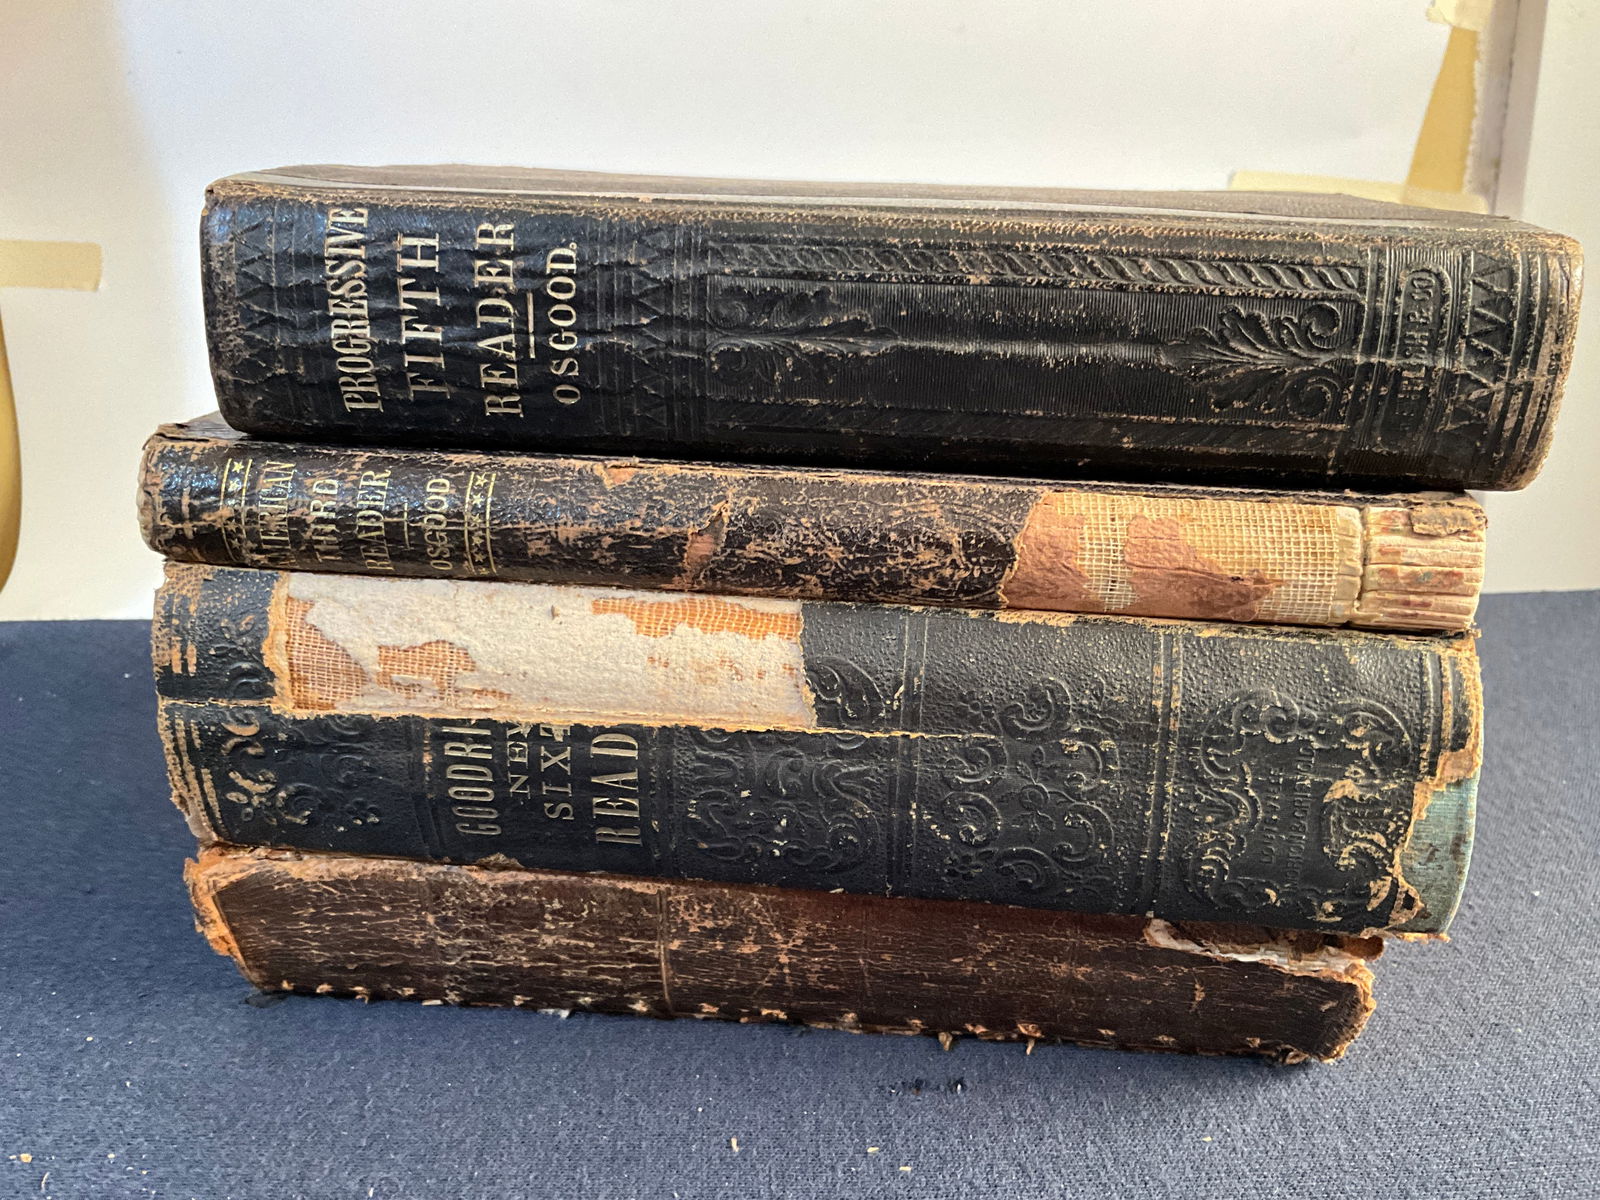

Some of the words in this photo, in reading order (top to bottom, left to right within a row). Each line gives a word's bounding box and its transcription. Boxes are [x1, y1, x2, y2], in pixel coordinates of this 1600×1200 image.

[325, 208, 383, 413] PROGRESSIVE
[397, 232, 450, 401] FIFTH
[474, 222, 524, 418] READER
[547, 242, 581, 405] OSGOOD.
[310, 479, 343, 563] THIRD
[356, 469, 396, 572] READER
[424, 478, 453, 571] OSGOOD
[591, 733, 643, 847] READ
